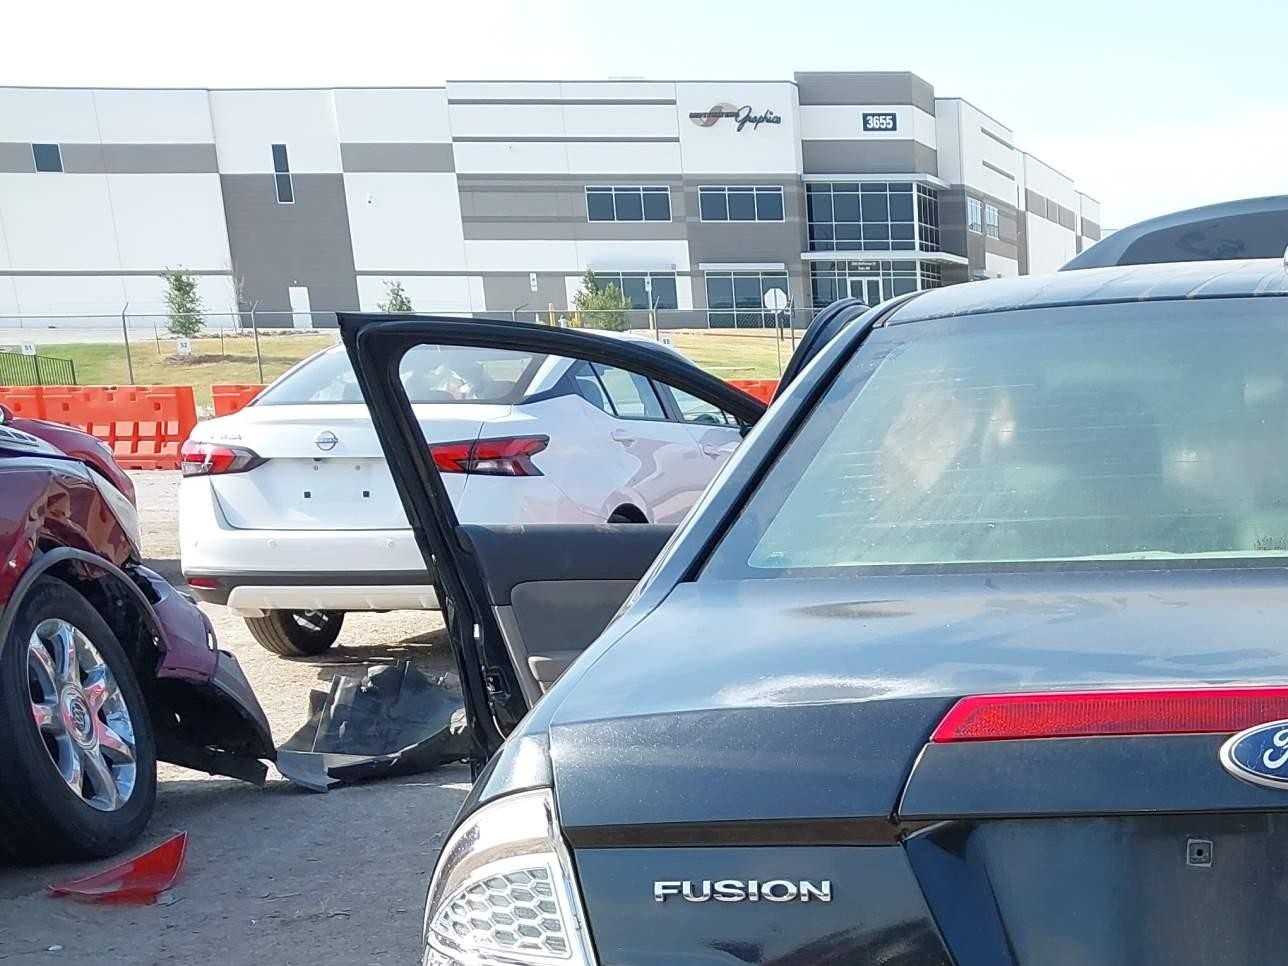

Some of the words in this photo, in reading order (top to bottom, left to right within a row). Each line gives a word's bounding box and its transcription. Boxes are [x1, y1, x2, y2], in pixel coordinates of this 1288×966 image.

[735, 105, 782, 132] Graphics
[866, 115, 894, 129] 3655
[653, 880, 833, 903] FUSION
